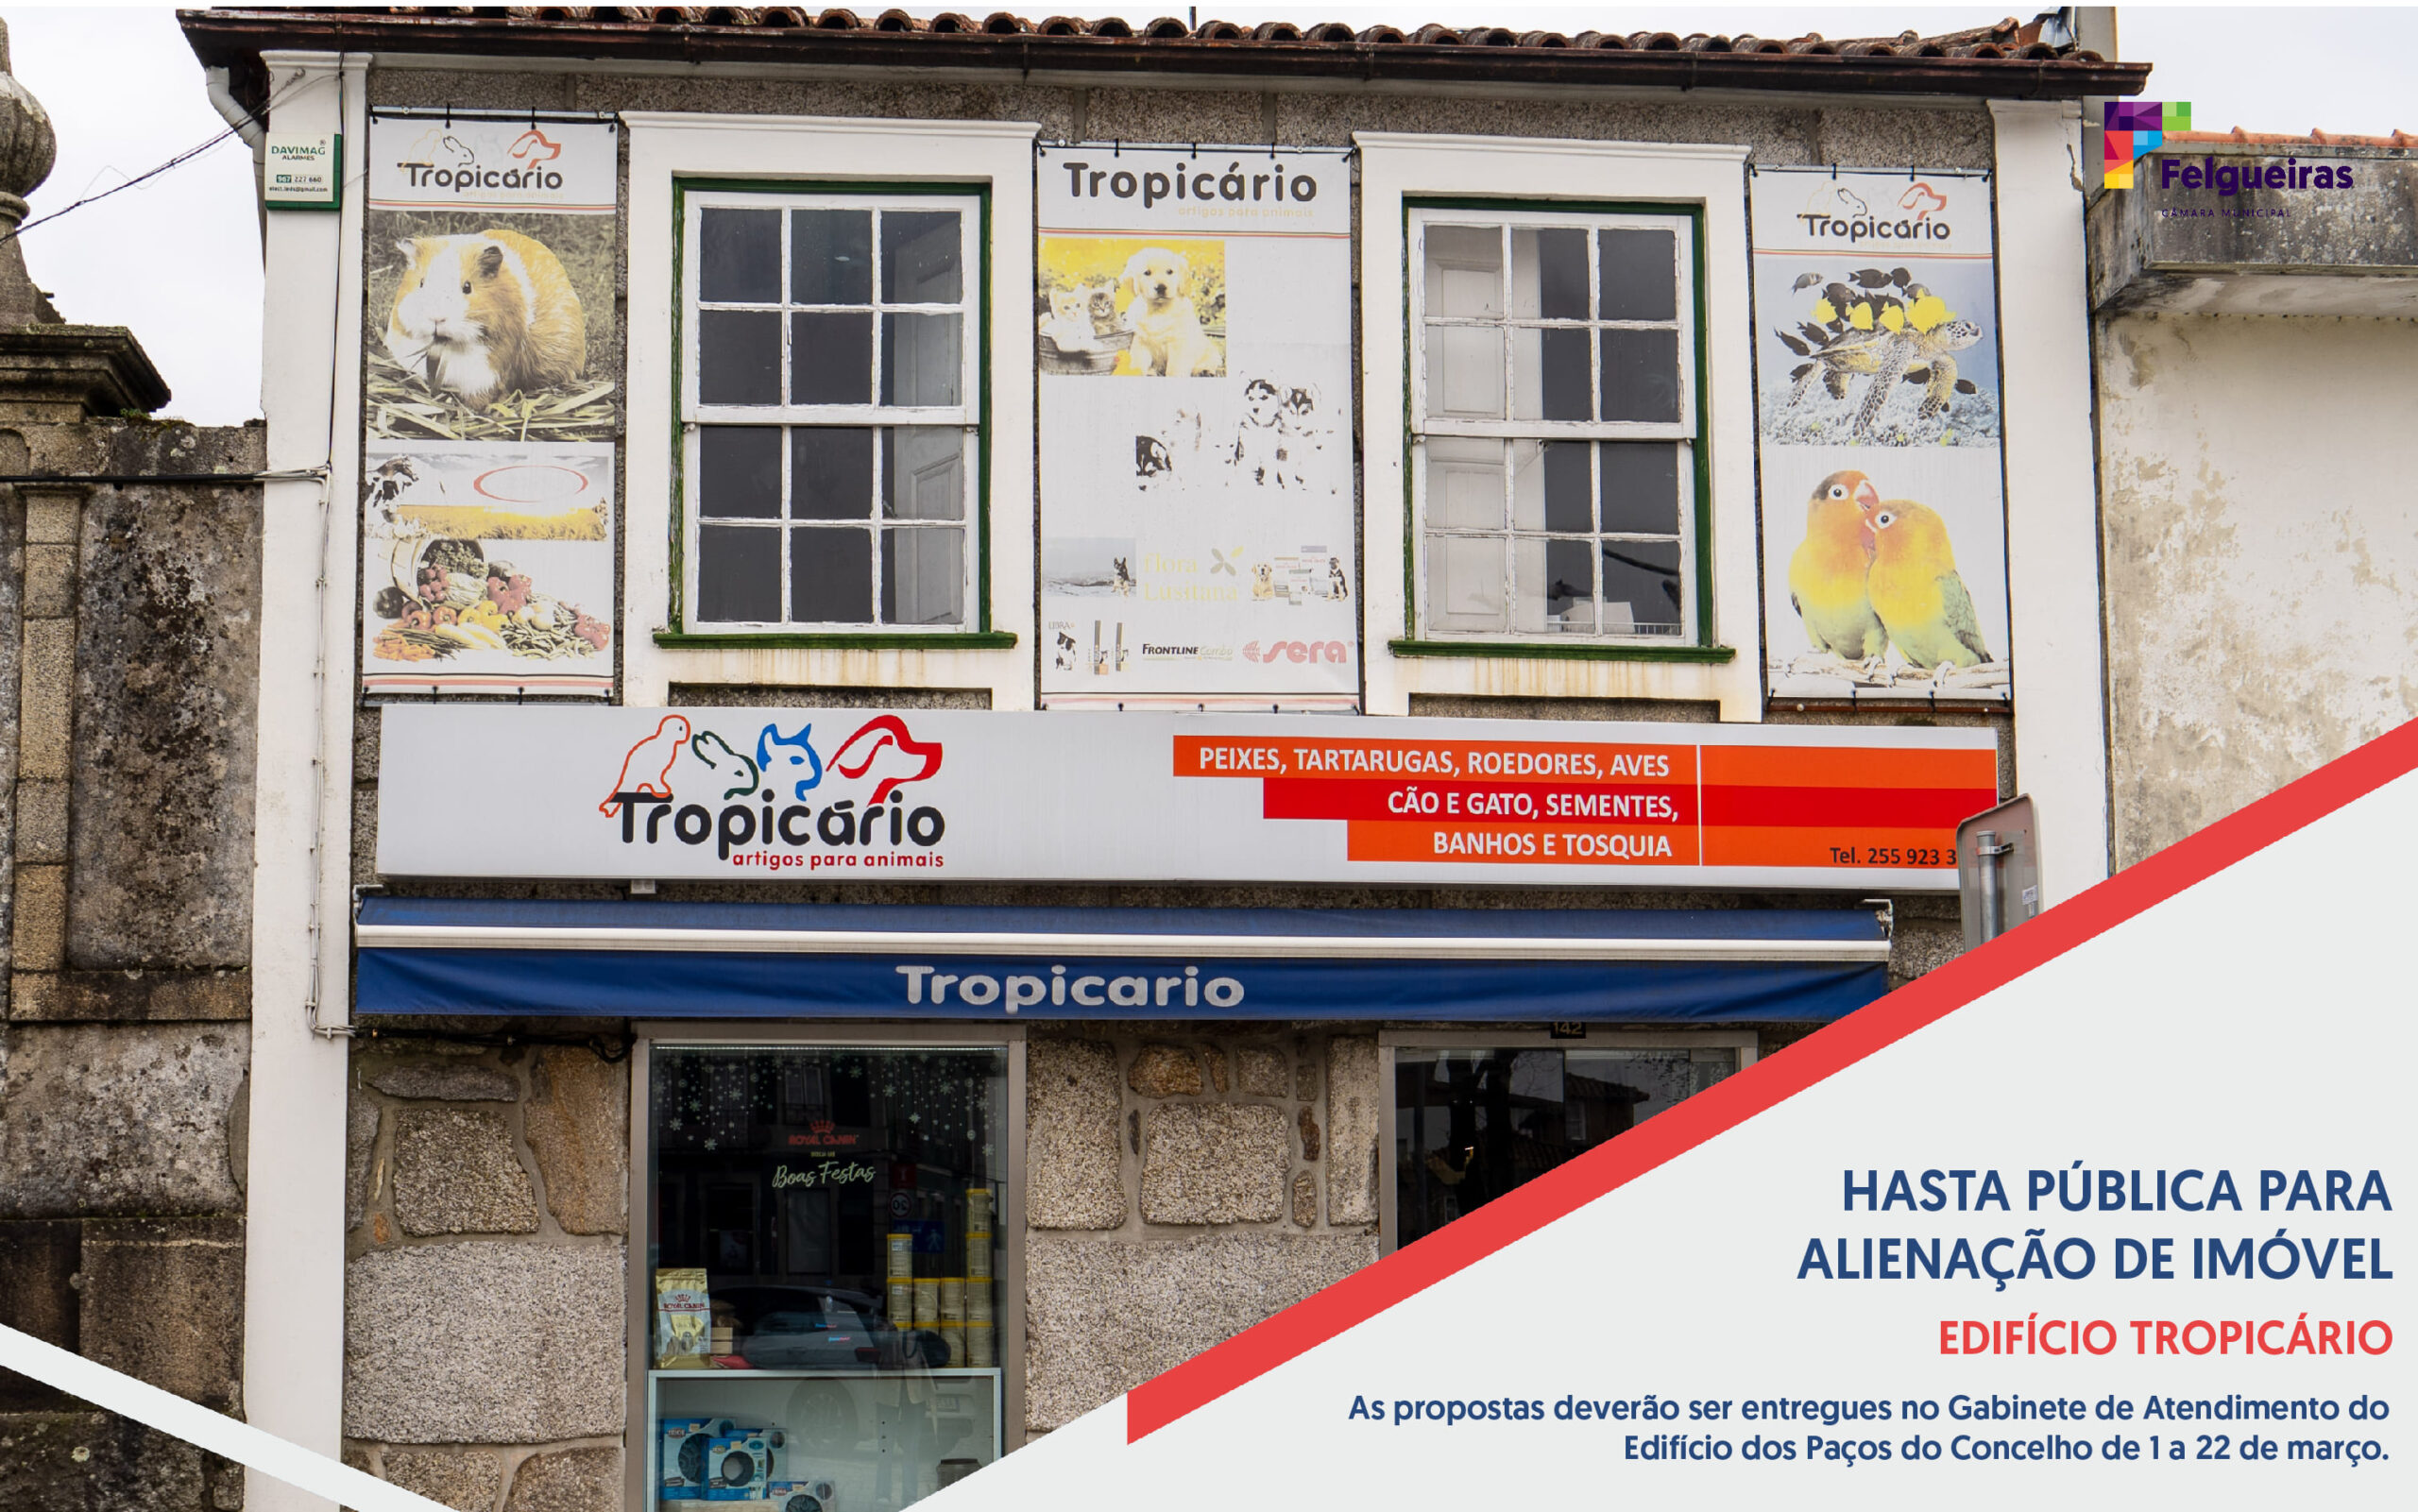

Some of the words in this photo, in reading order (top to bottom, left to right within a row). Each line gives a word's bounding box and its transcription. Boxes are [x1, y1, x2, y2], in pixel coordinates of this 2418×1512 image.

[271, 145, 326, 156] DAVIMAG
[397, 162, 563, 193] Tropicário
[1063, 161, 1317, 209] Tropicário
[1178, 207, 1225, 218] artigos
[1228, 208, 1259, 217] para
[1262, 207, 1315, 217] animais
[1796, 213, 1950, 243] Tropicário
[1142, 643, 1200, 655] FRONTLINE
[1263, 640, 1348, 664] sera
[1199, 746, 1286, 774] PEIXES,
[1293, 748, 1459, 777] TARTARUGAS,
[1469, 751, 1604, 780] ROEDORES,
[1609, 754, 1670, 777] AVES
[1388, 786, 1439, 814] CÃO
[1447, 793, 1460, 814] E
[1467, 793, 1539, 820] GATO,
[1545, 794, 1678, 823] SEMENTES,
[610, 789, 945, 860] Tropicário
[1434, 831, 1536, 856] BANHOS
[1543, 834, 1557, 856] E
[1562, 834, 1672, 859] TOSQUIA
[1830, 847, 1861, 864] Tel.
[1868, 848, 1901, 864] 255
[1907, 849, 1940, 865] 923
[733, 851, 804, 871] artigos
[810, 855, 857, 871] para
[863, 851, 944, 867] animais
[895, 965, 1245, 1014] Tropicario
[1554, 1021, 1583, 1035] 142
[772, 1164, 817, 1188] Boas
[818, 1161, 877, 1184] Festas
